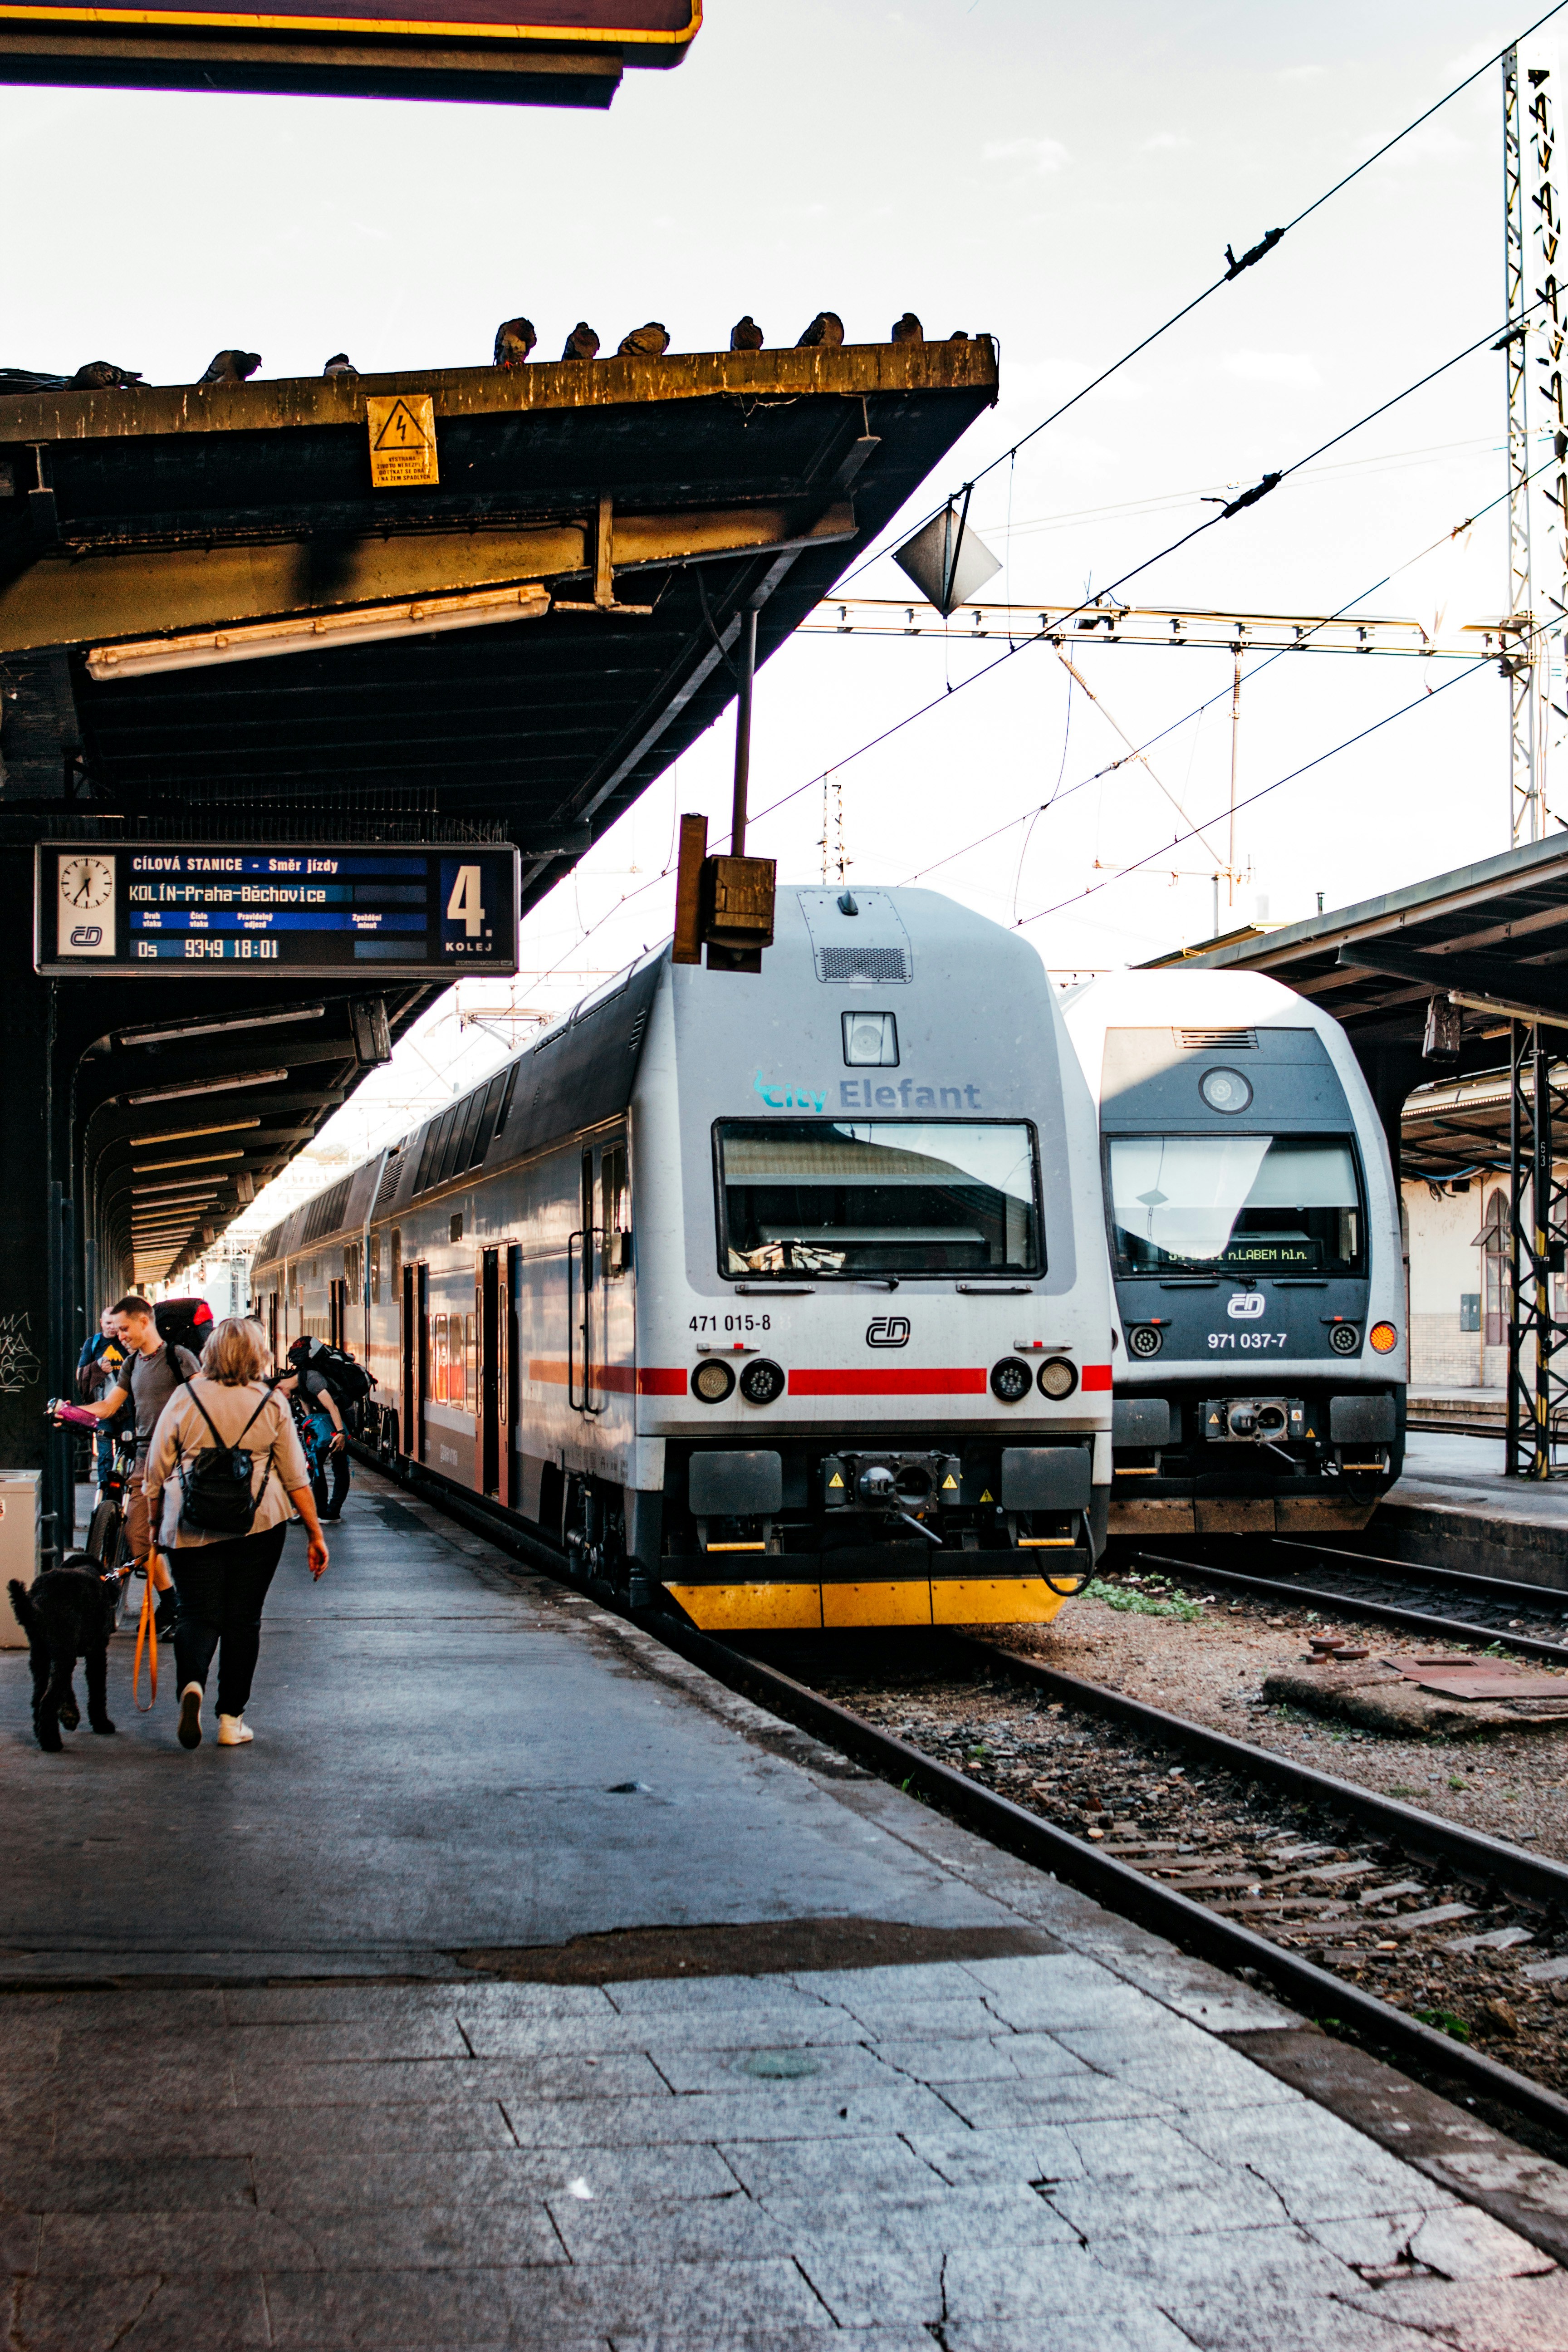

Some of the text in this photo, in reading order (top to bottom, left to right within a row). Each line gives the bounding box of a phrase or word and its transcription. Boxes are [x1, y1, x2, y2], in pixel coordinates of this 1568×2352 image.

[133, 856, 181, 870] CÍLOVÁ
[187, 858, 242, 871] STANICE
[269, 858, 301, 871] Směr
[307, 859, 338, 874] jízdy
[129, 883, 326, 902] KOLÍN-Praha-Běchovice
[447, 866, 493, 937] 4.
[190, 911, 208, 920] Číslo
[237, 912, 273, 922] Pravidelný
[244, 921, 267, 929] odjezd
[138, 939, 278, 958] Os 9349 18:01
[445, 942, 492, 952] KOLEJ
[754, 1070, 982, 1112] City Elefant
[1228, 1250, 1277, 1260] n.LABEM
[1281, 1249, 1307, 1260] hl.n.
[689, 1314, 771, 1331] 471 015-8
[1207, 1333, 1287, 1348] 971 037-7
